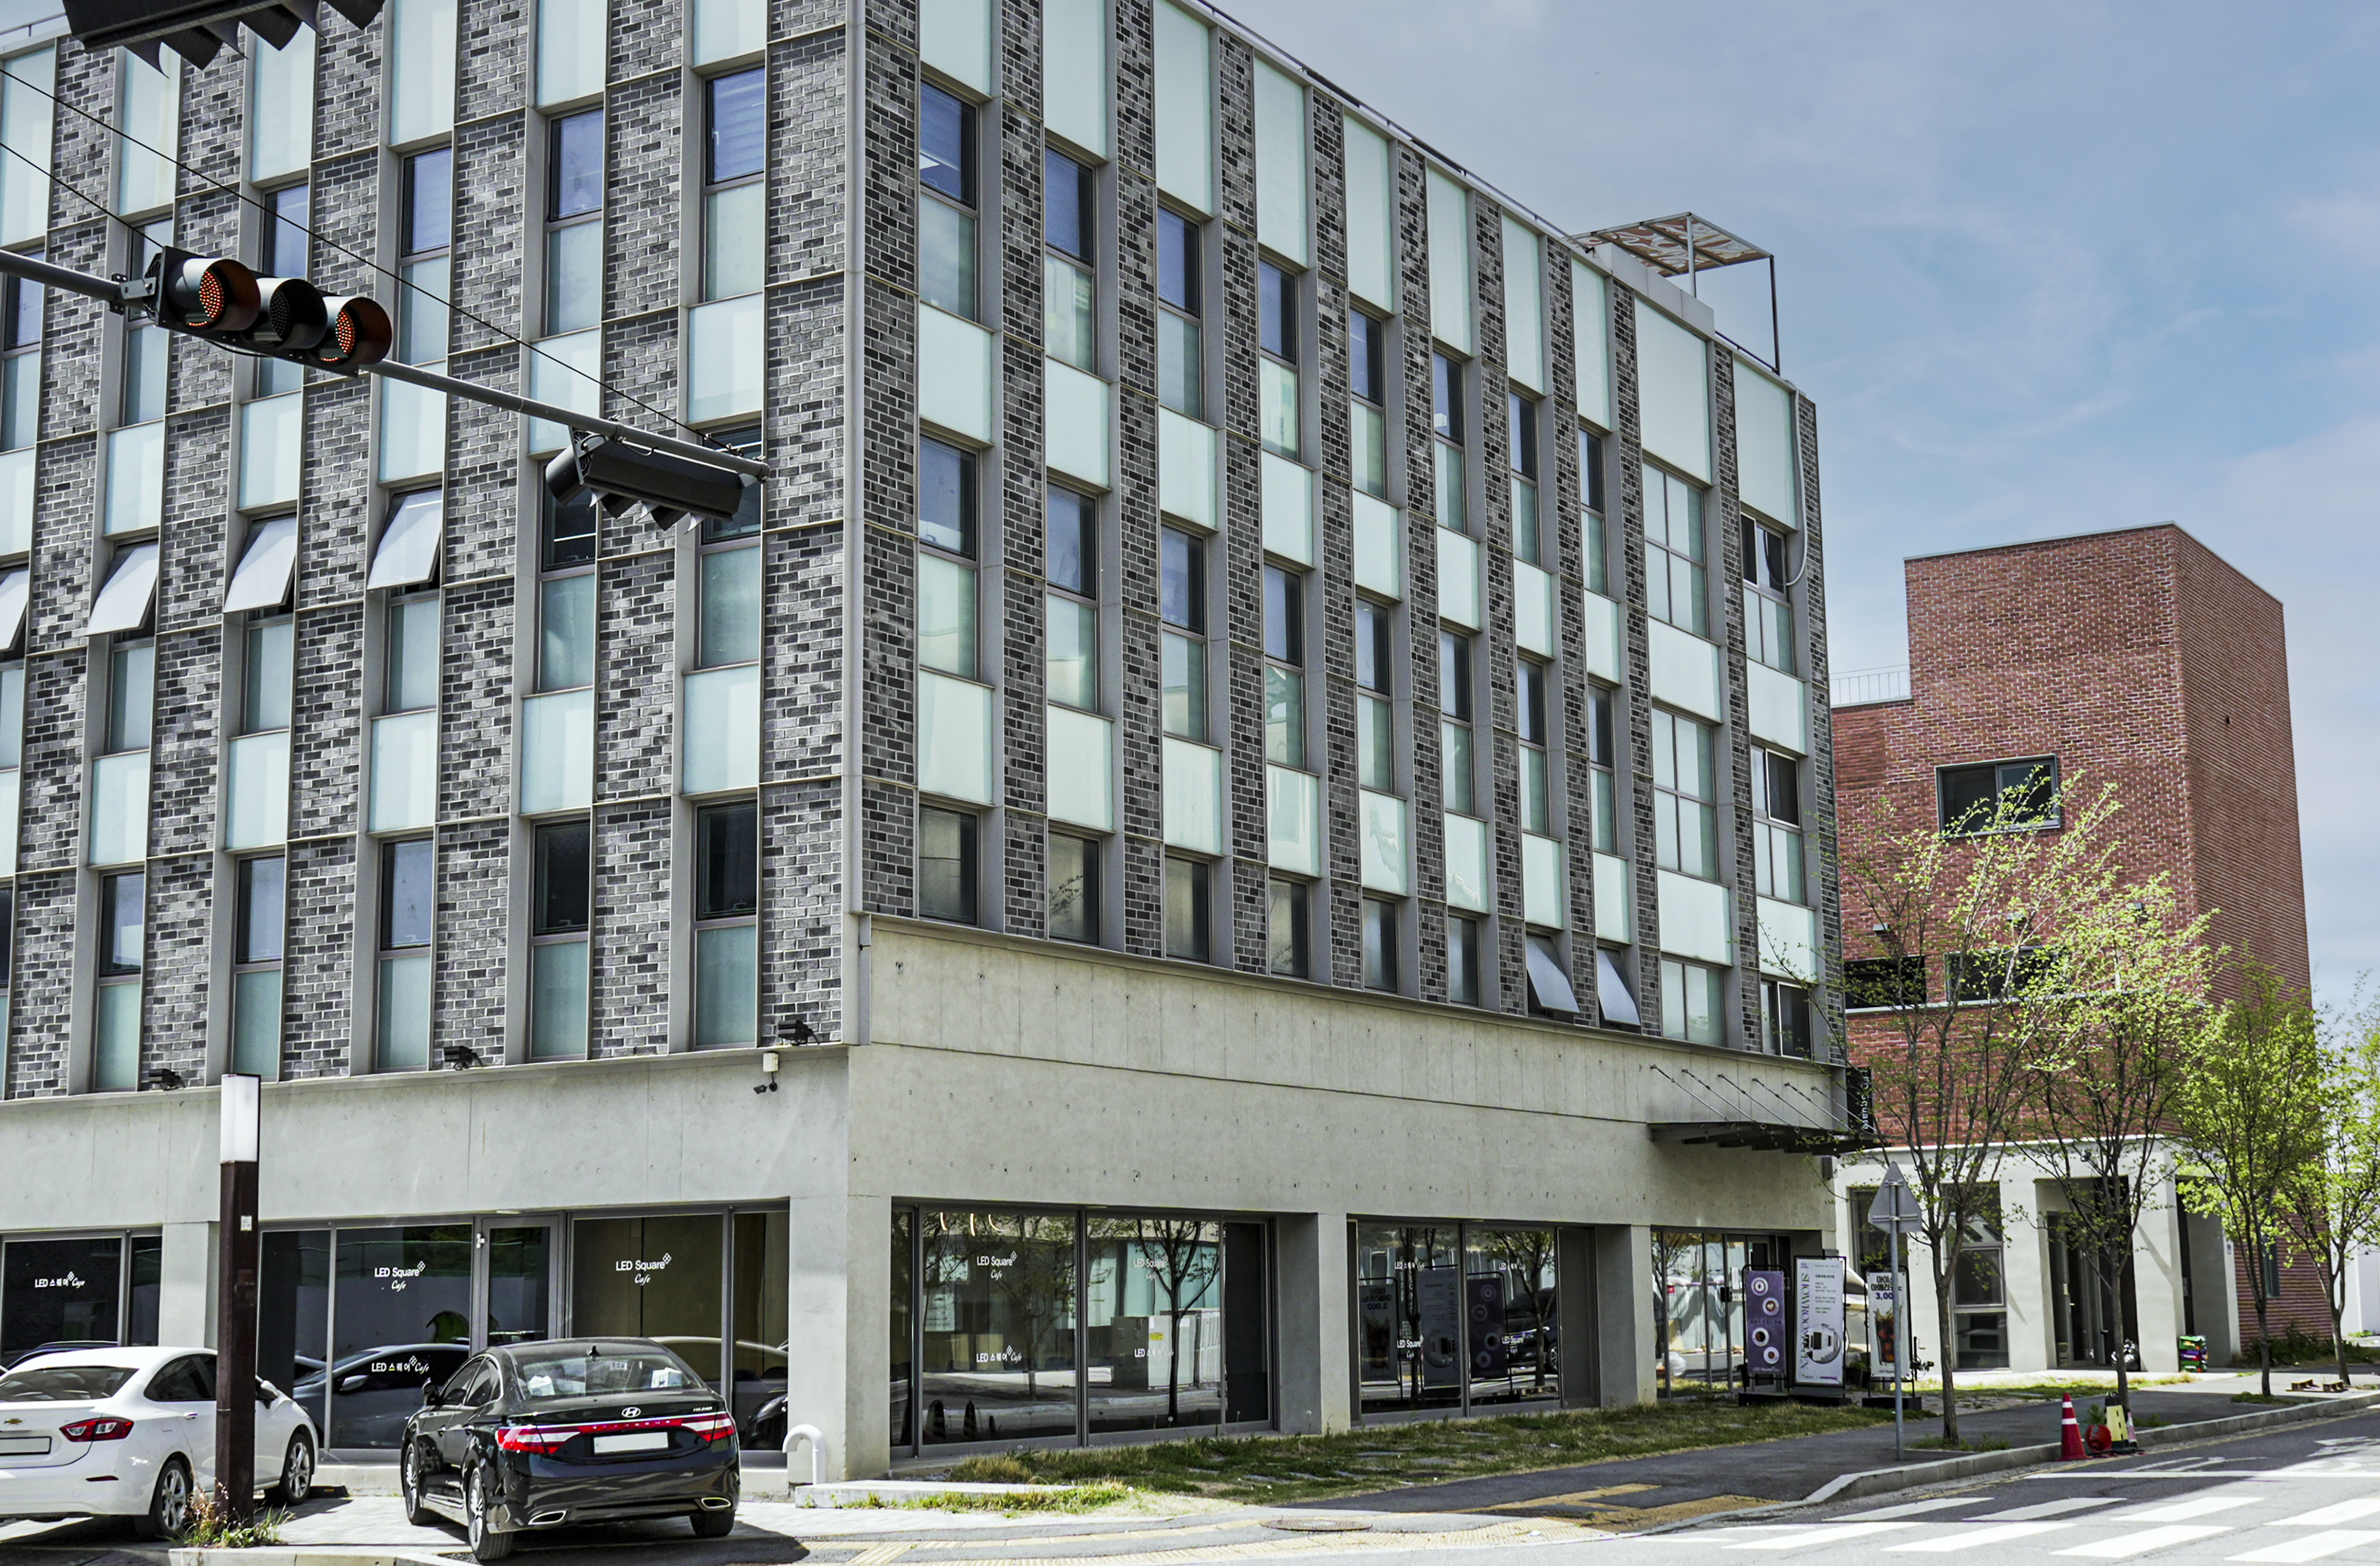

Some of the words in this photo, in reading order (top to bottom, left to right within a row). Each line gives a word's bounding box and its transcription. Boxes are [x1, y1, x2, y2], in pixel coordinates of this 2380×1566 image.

[616, 1260, 633, 1271] LED
[635, 1260, 665, 1271] Square
[977, 1256, 990, 1266] LED
[991, 1256, 1012, 1267] Square
[374, 1267, 390, 1277] LED
[392, 1267, 420, 1278] Square
[35, 1279, 48, 1287] LED
[1397, 1340, 1406, 1348] LED
[976, 1352, 988, 1363] LED
[1134, 1348, 1145, 1358] LED
[371, 1362, 387, 1372] LED
